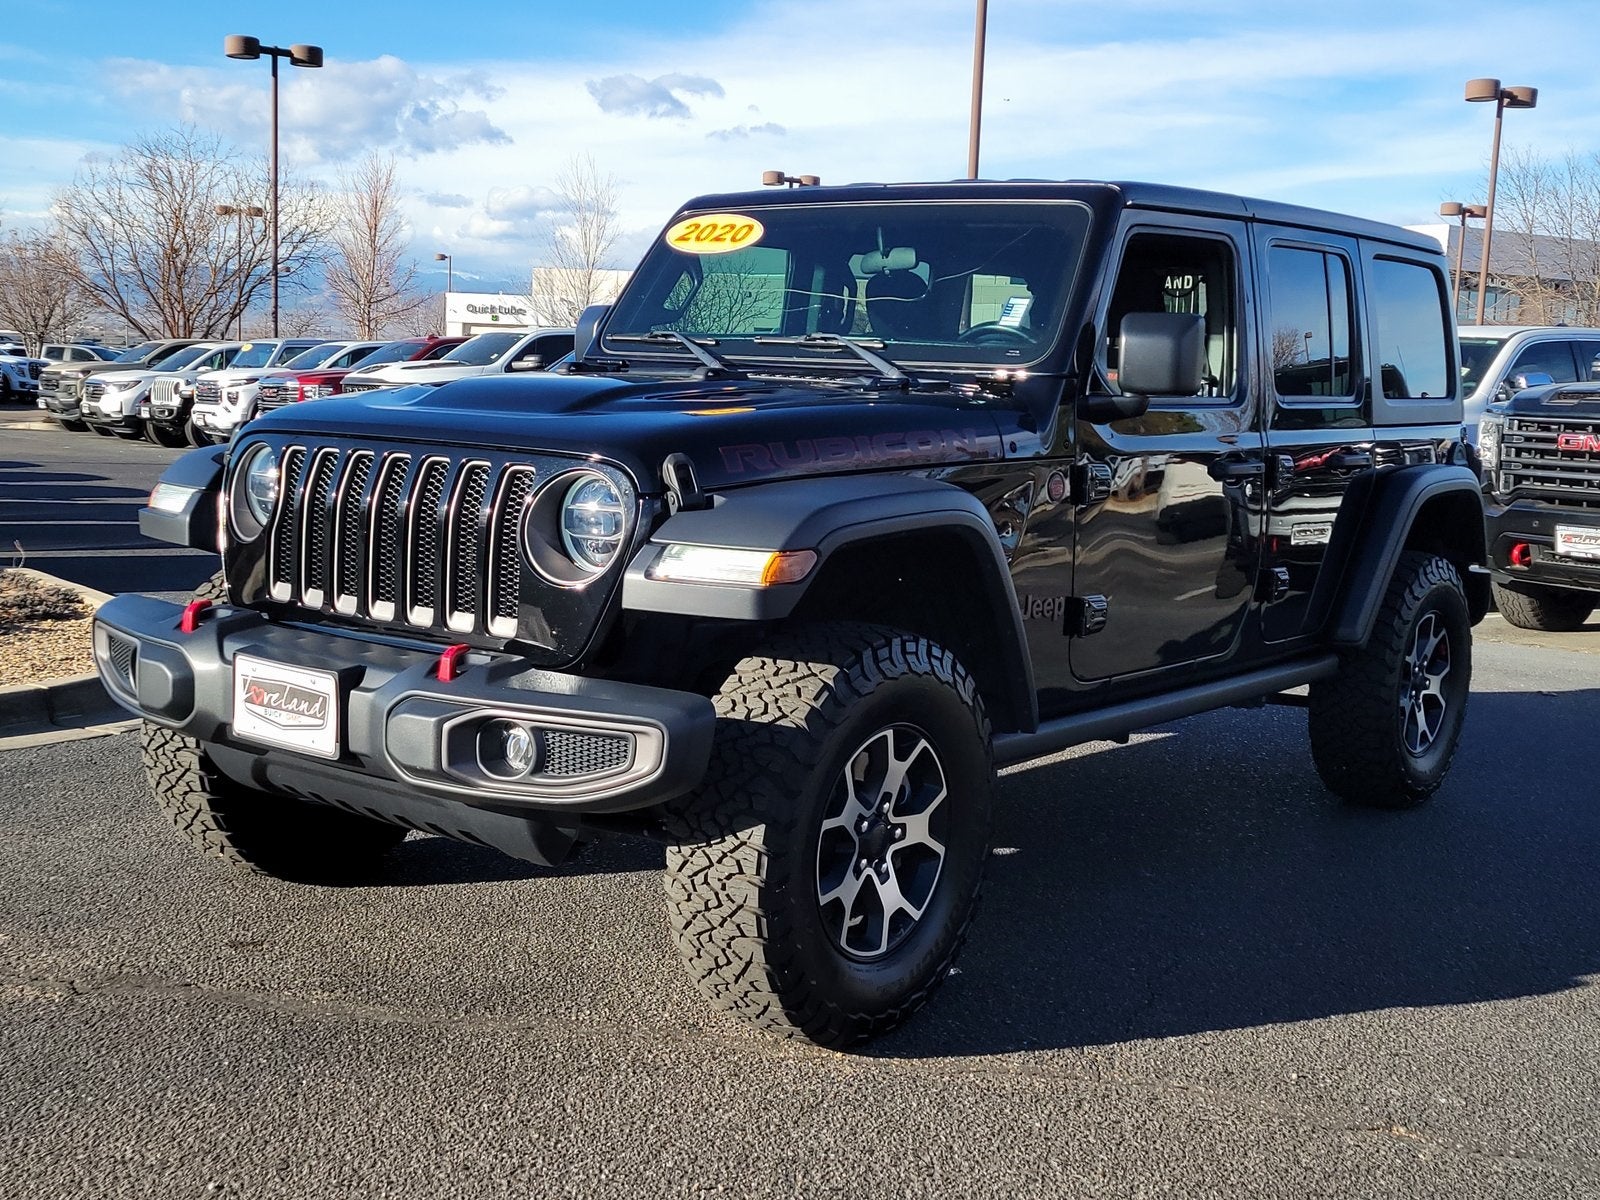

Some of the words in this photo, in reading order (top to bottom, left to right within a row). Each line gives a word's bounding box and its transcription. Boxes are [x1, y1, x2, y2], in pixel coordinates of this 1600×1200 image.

[674, 223, 755, 243] 2020
[466, 303, 498, 315] Quick
[498, 305, 527, 316] Lube
[718, 428, 978, 474] RUBICON
[1557, 433, 1600, 452] GM
[1022, 594, 1065, 622] Jeep
[241, 675, 325, 718] Loveland
